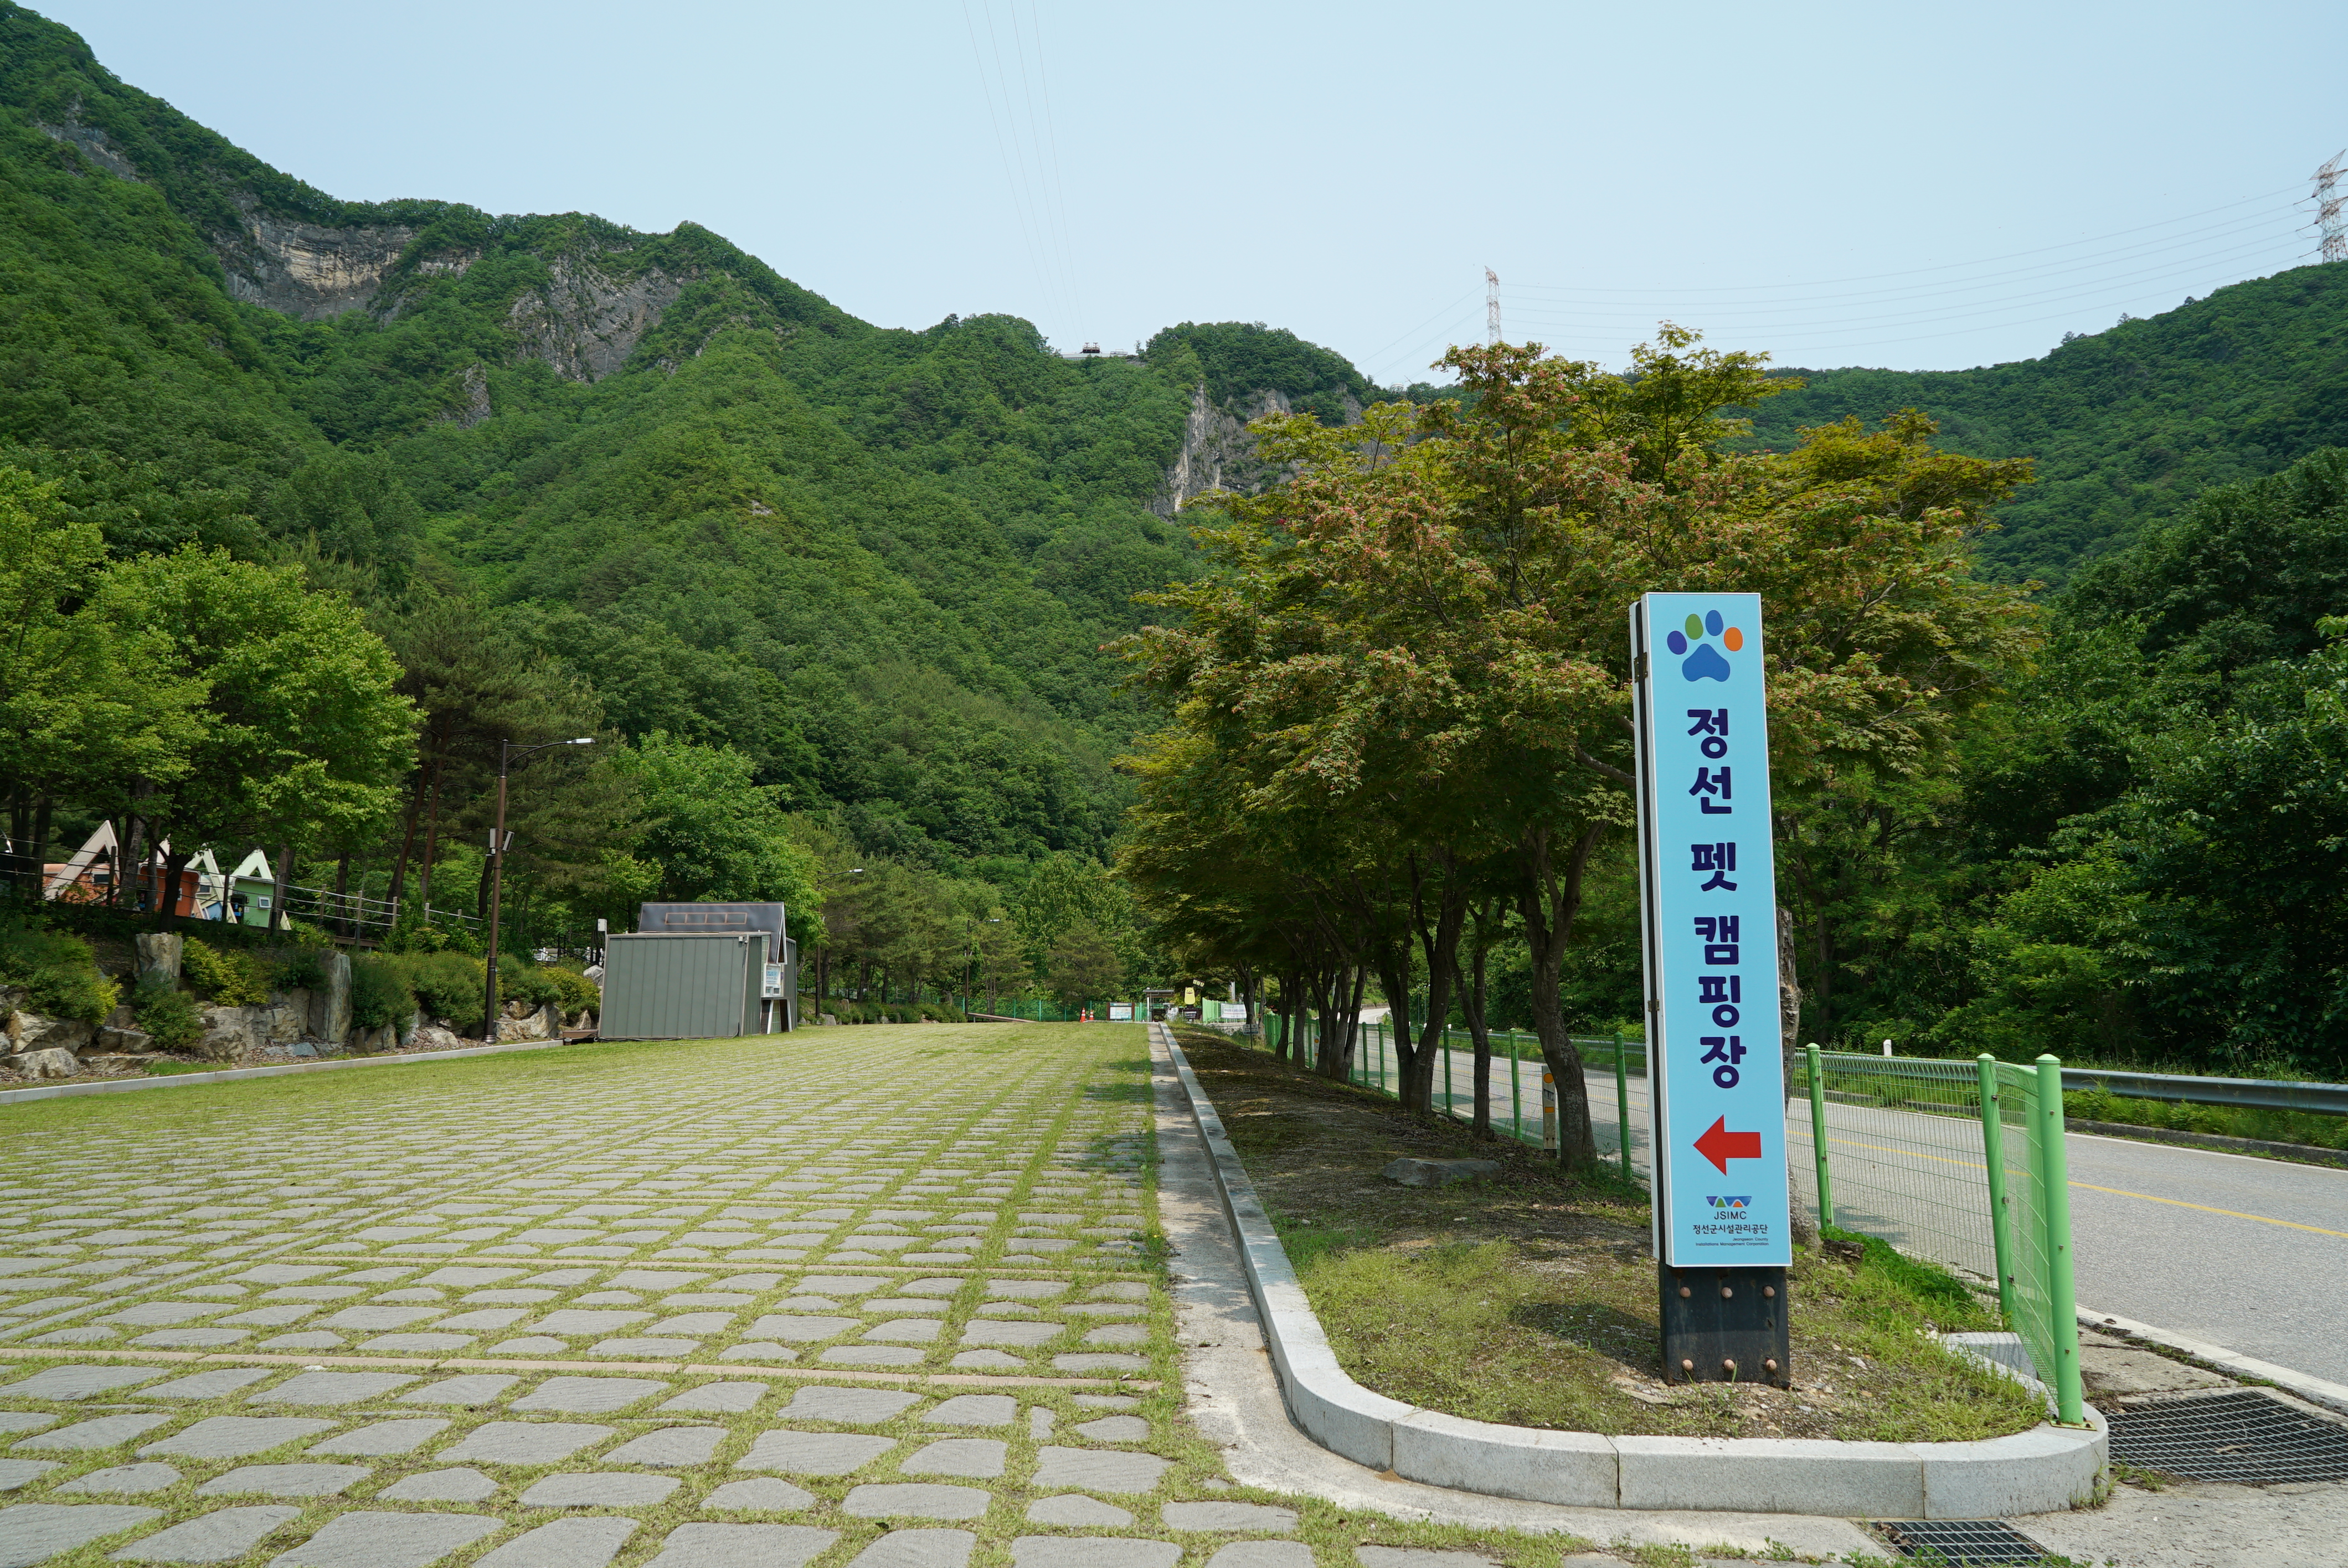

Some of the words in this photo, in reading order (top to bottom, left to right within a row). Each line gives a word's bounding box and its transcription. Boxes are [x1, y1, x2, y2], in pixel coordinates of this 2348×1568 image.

[1687, 708, 1733, 814] 정선
[1691, 843, 1738, 891] 펫
[1694, 916, 1747, 1089] 캠핑장
[1692, 1224, 1768, 1234] 정선군시설관리공단
[1713, 1211, 1747, 1220] JSIMC
